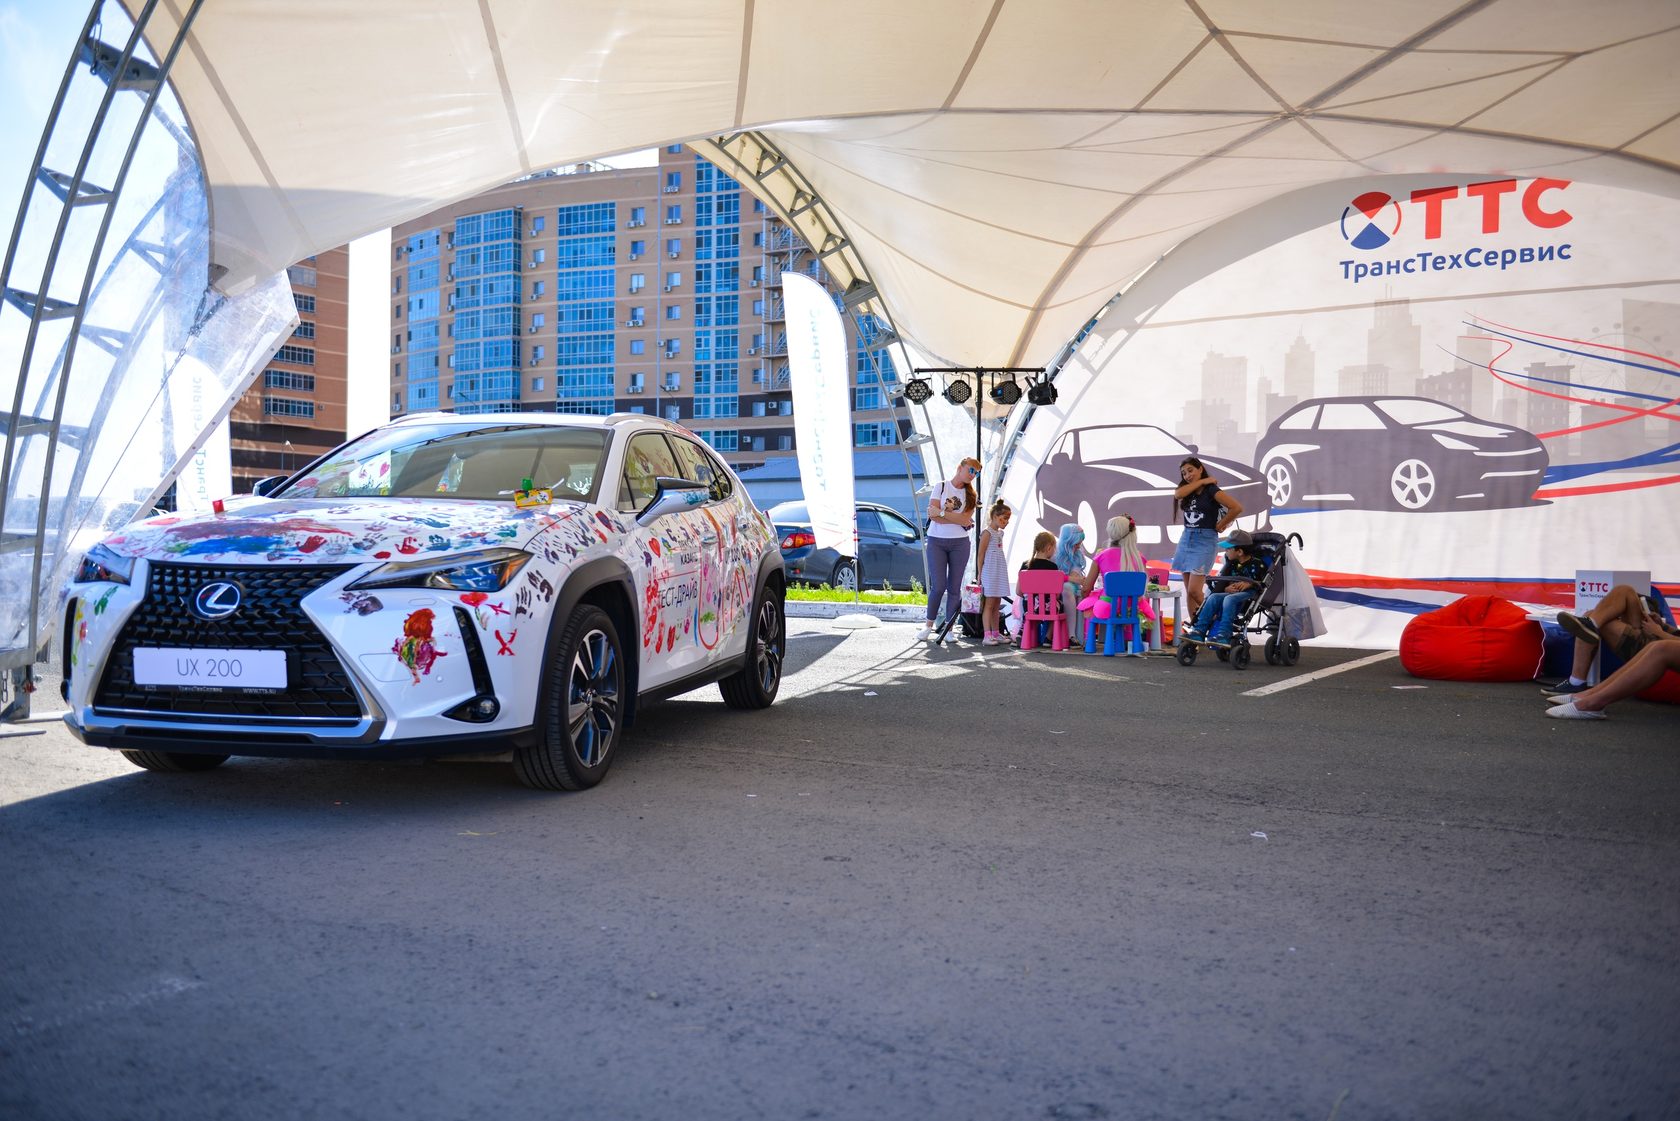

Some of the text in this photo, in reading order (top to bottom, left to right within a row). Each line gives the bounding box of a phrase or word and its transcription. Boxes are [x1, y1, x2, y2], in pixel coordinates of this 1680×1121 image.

[1410, 177, 1574, 240] ТТС
[1339, 243, 1572, 283] ТрансТехСервис
[658, 577, 698, 609] ТЕСТ-ДРАЙВ
[1588, 582, 1608, 593] ТТС
[176, 658, 243, 678] UX 200
